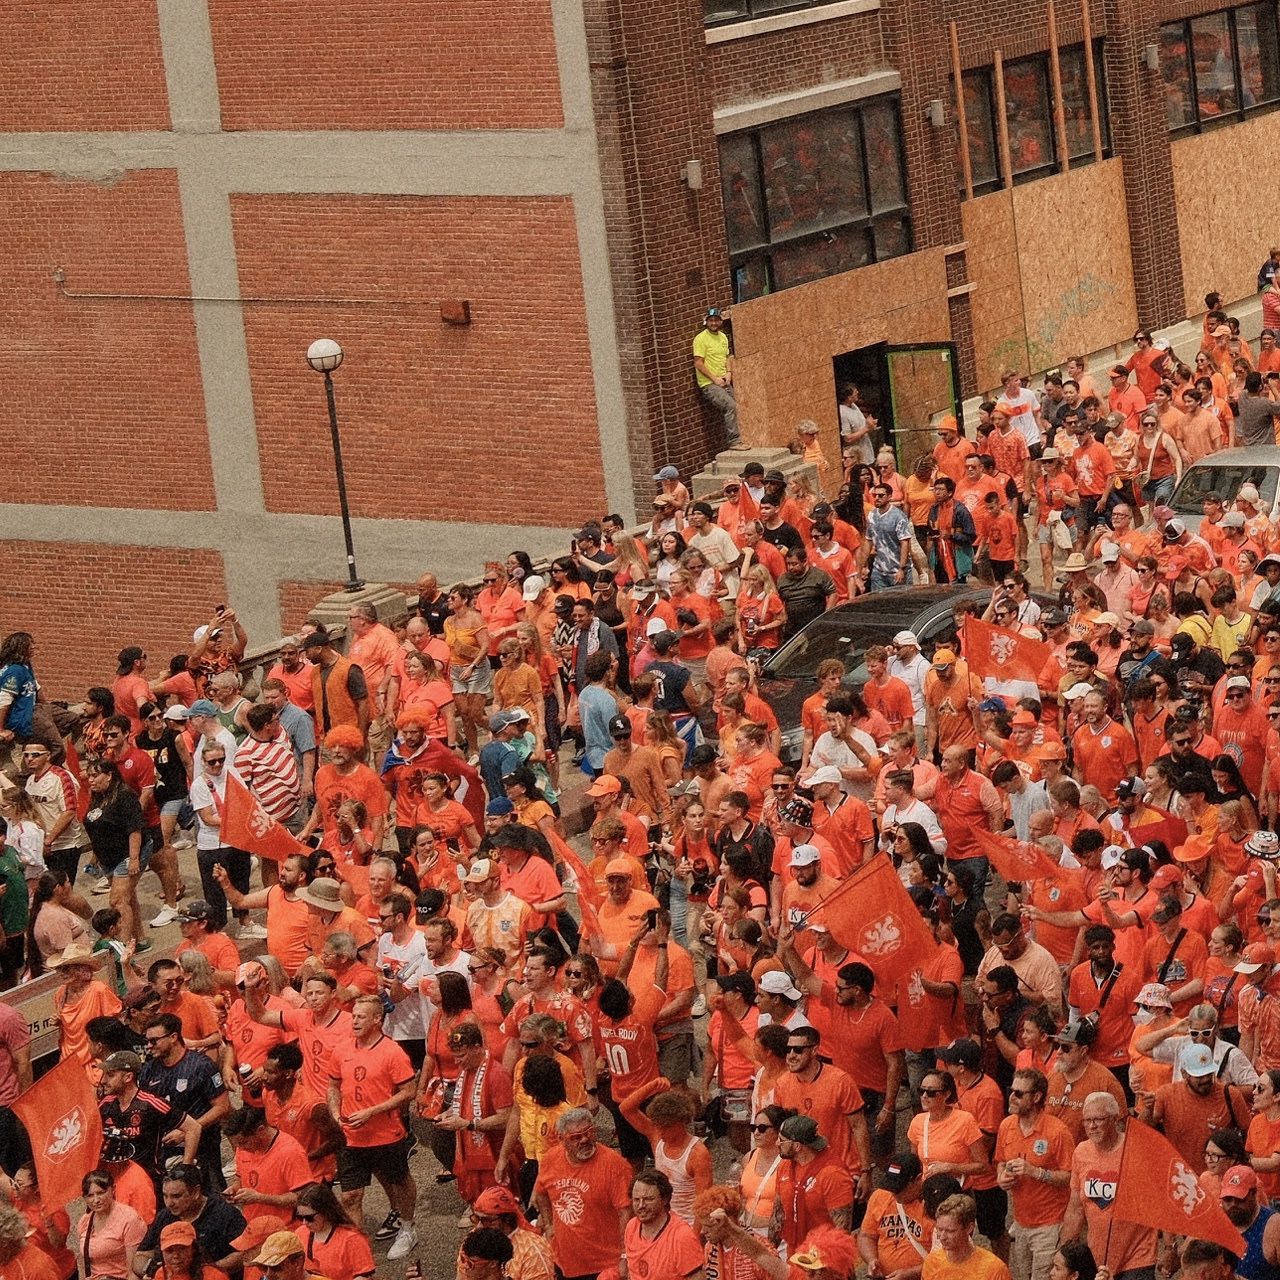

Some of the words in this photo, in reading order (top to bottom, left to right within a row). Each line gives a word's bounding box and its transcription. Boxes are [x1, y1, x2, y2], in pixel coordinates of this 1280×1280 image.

[605, 1042, 630, 1075] 10
[355, 1086, 362, 1103] 6
[1089, 1178, 1113, 1200] KC
